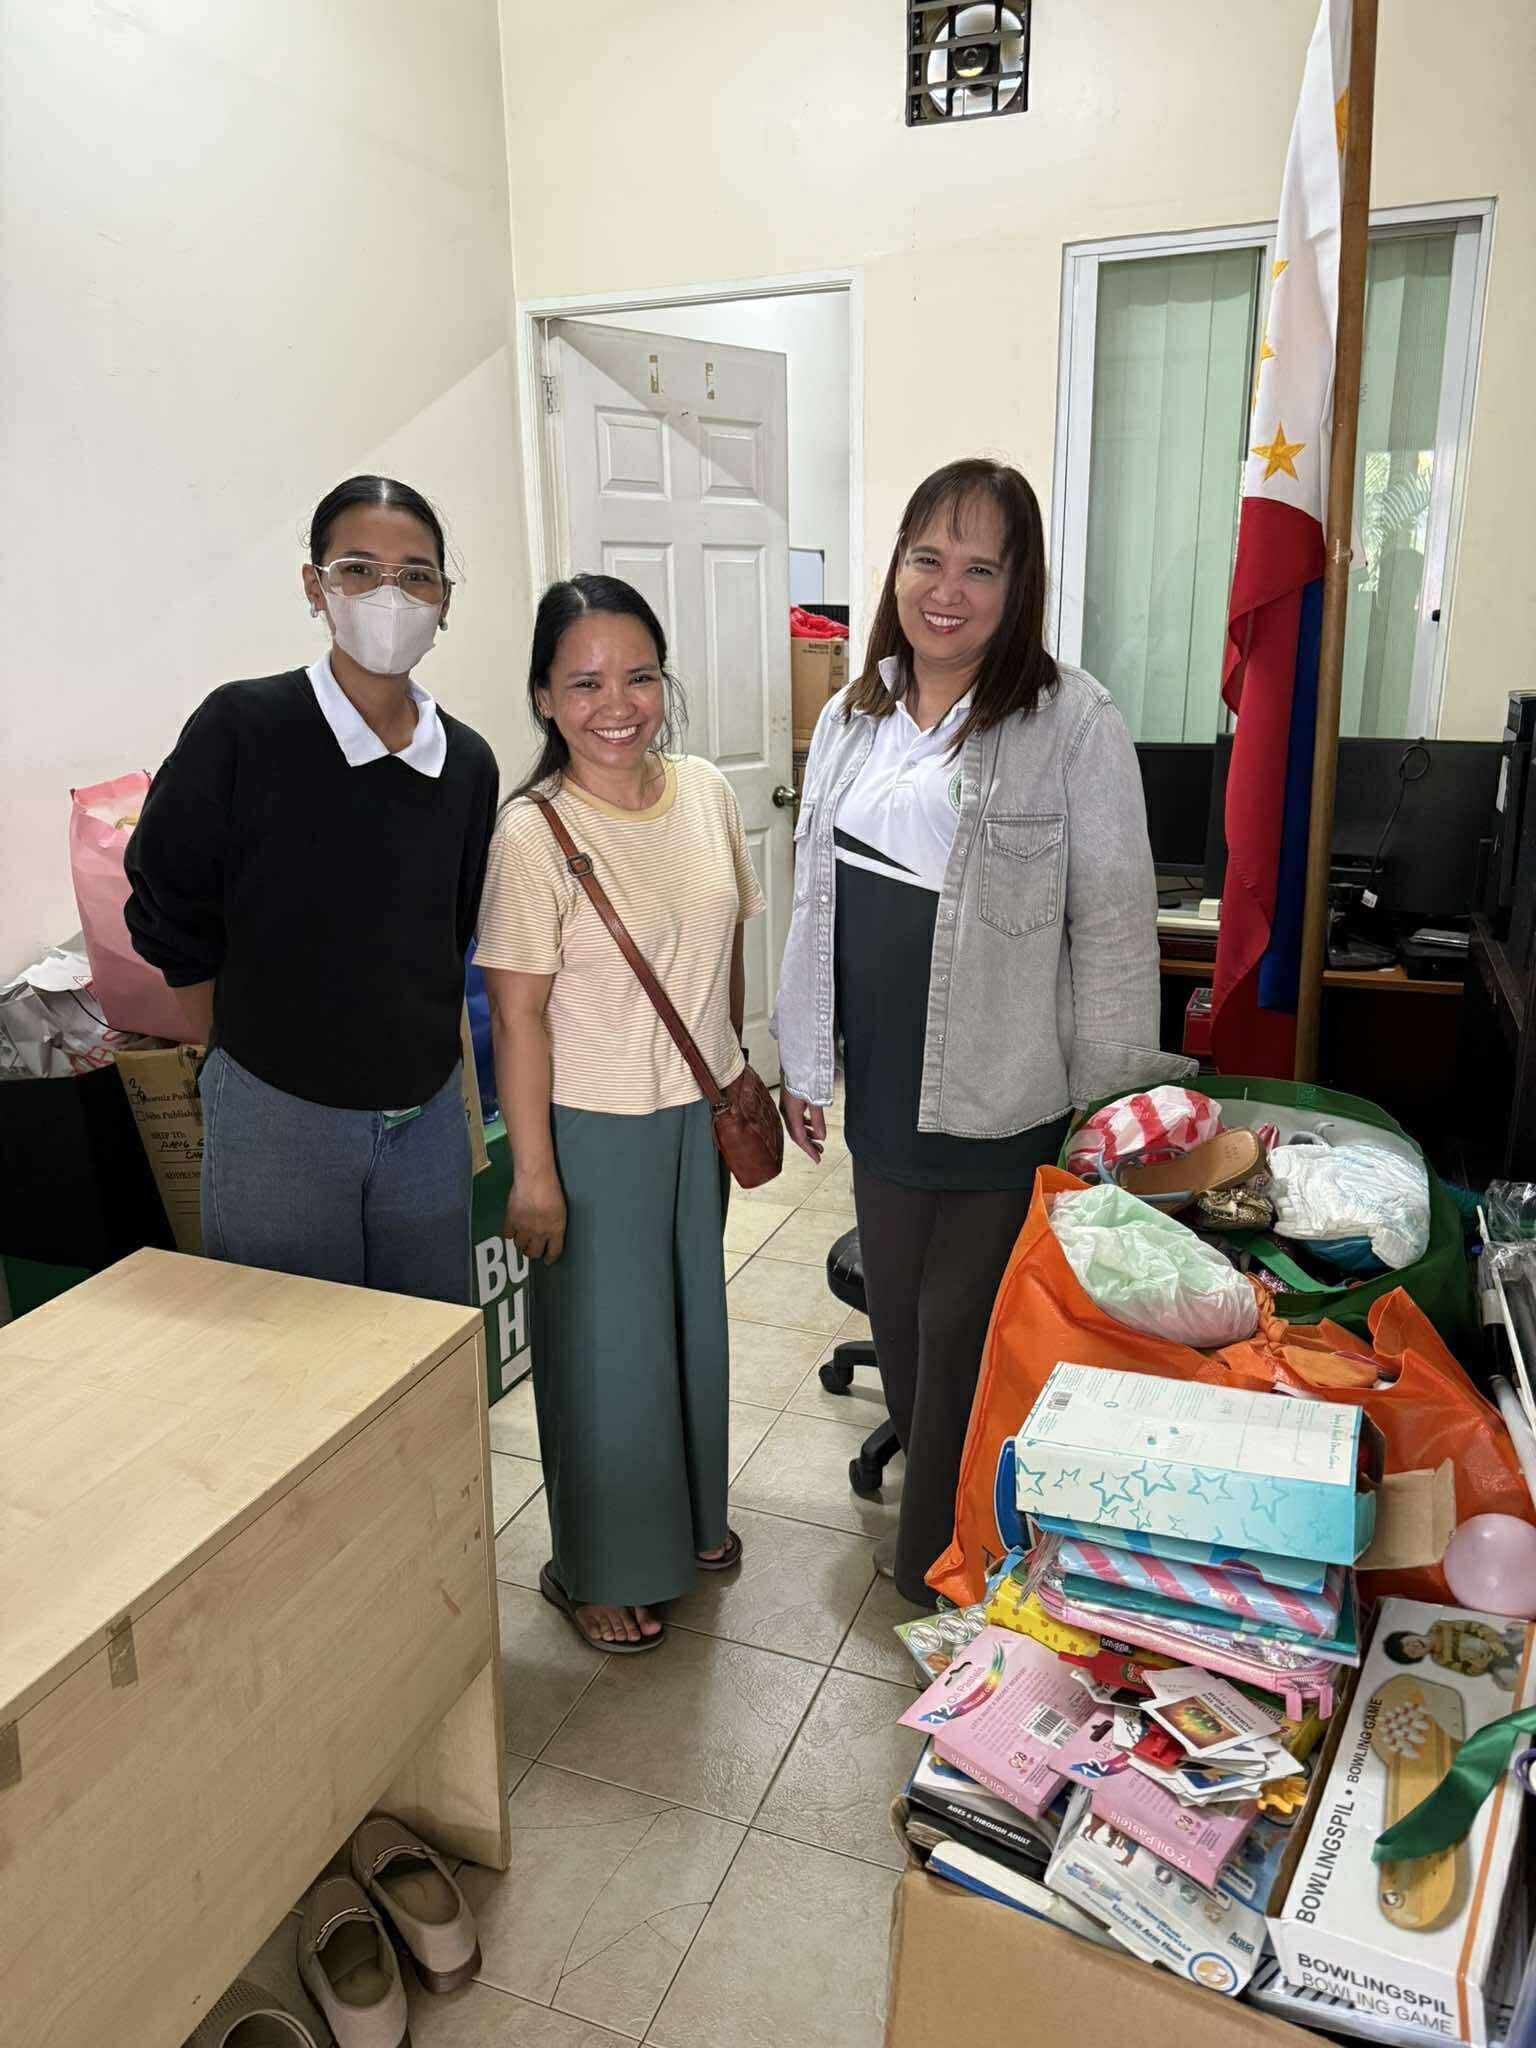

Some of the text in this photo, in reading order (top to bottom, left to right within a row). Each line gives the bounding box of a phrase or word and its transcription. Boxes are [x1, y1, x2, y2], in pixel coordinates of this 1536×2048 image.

[930, 1703, 956, 1723] 12
[1080, 1757, 1109, 1779] 12
[947, 1804, 967, 1818] AGES
[972, 1815, 1008, 1836] THROUGH
[1007, 1830, 1032, 1846] ADULT
[1111, 1810, 1193, 1868] 12 Oil Pastels
[1296, 1698, 1383, 1924] BOWLINGSPIL BOWLING GAME
[1297, 1952, 1455, 2018] BOWLINGSPIL
[1301, 1972, 1457, 2036] BOWLING GAME
